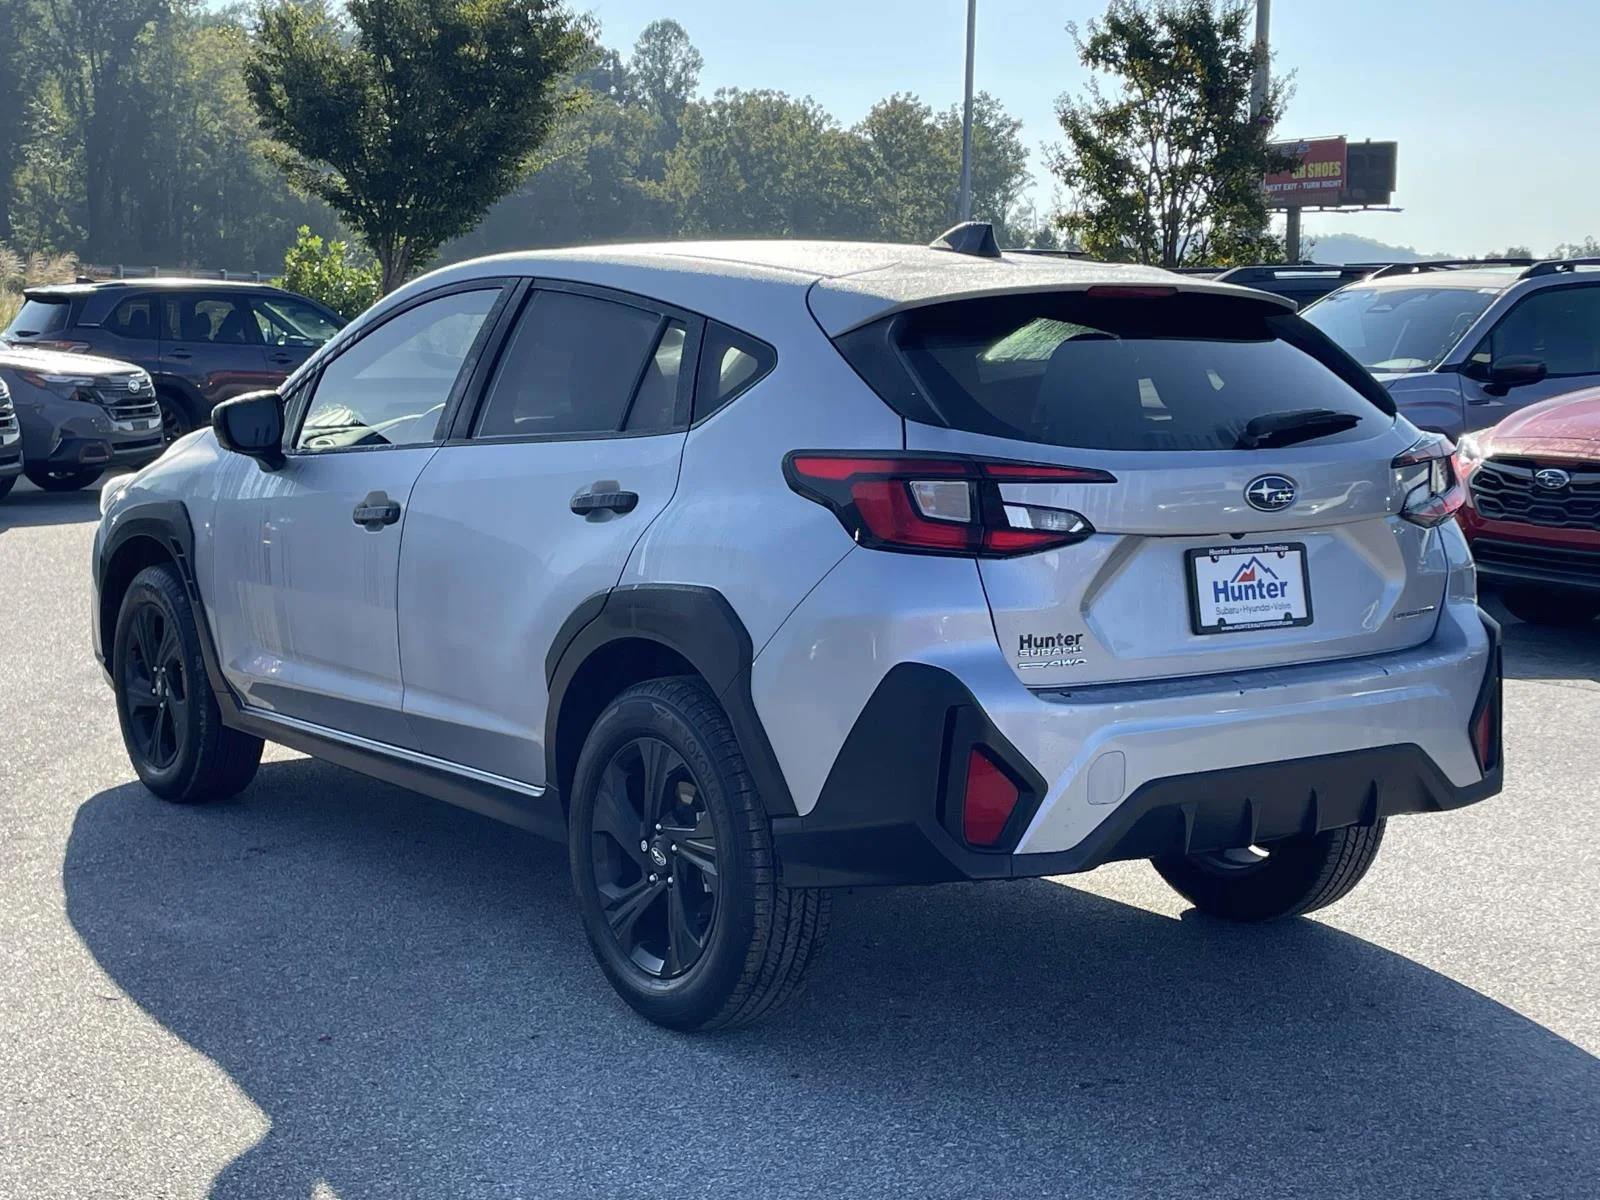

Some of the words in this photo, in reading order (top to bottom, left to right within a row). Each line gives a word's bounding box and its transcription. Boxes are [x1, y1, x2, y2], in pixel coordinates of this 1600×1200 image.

[1308, 161, 1341, 178] SHOES
[1303, 181, 1321, 189] TURN
[1209, 548, 1230, 556] Hunter
[1213, 579, 1288, 603] Hunter
[1019, 632, 1084, 650] Hunter
[1018, 646, 1084, 657] SUBARU
